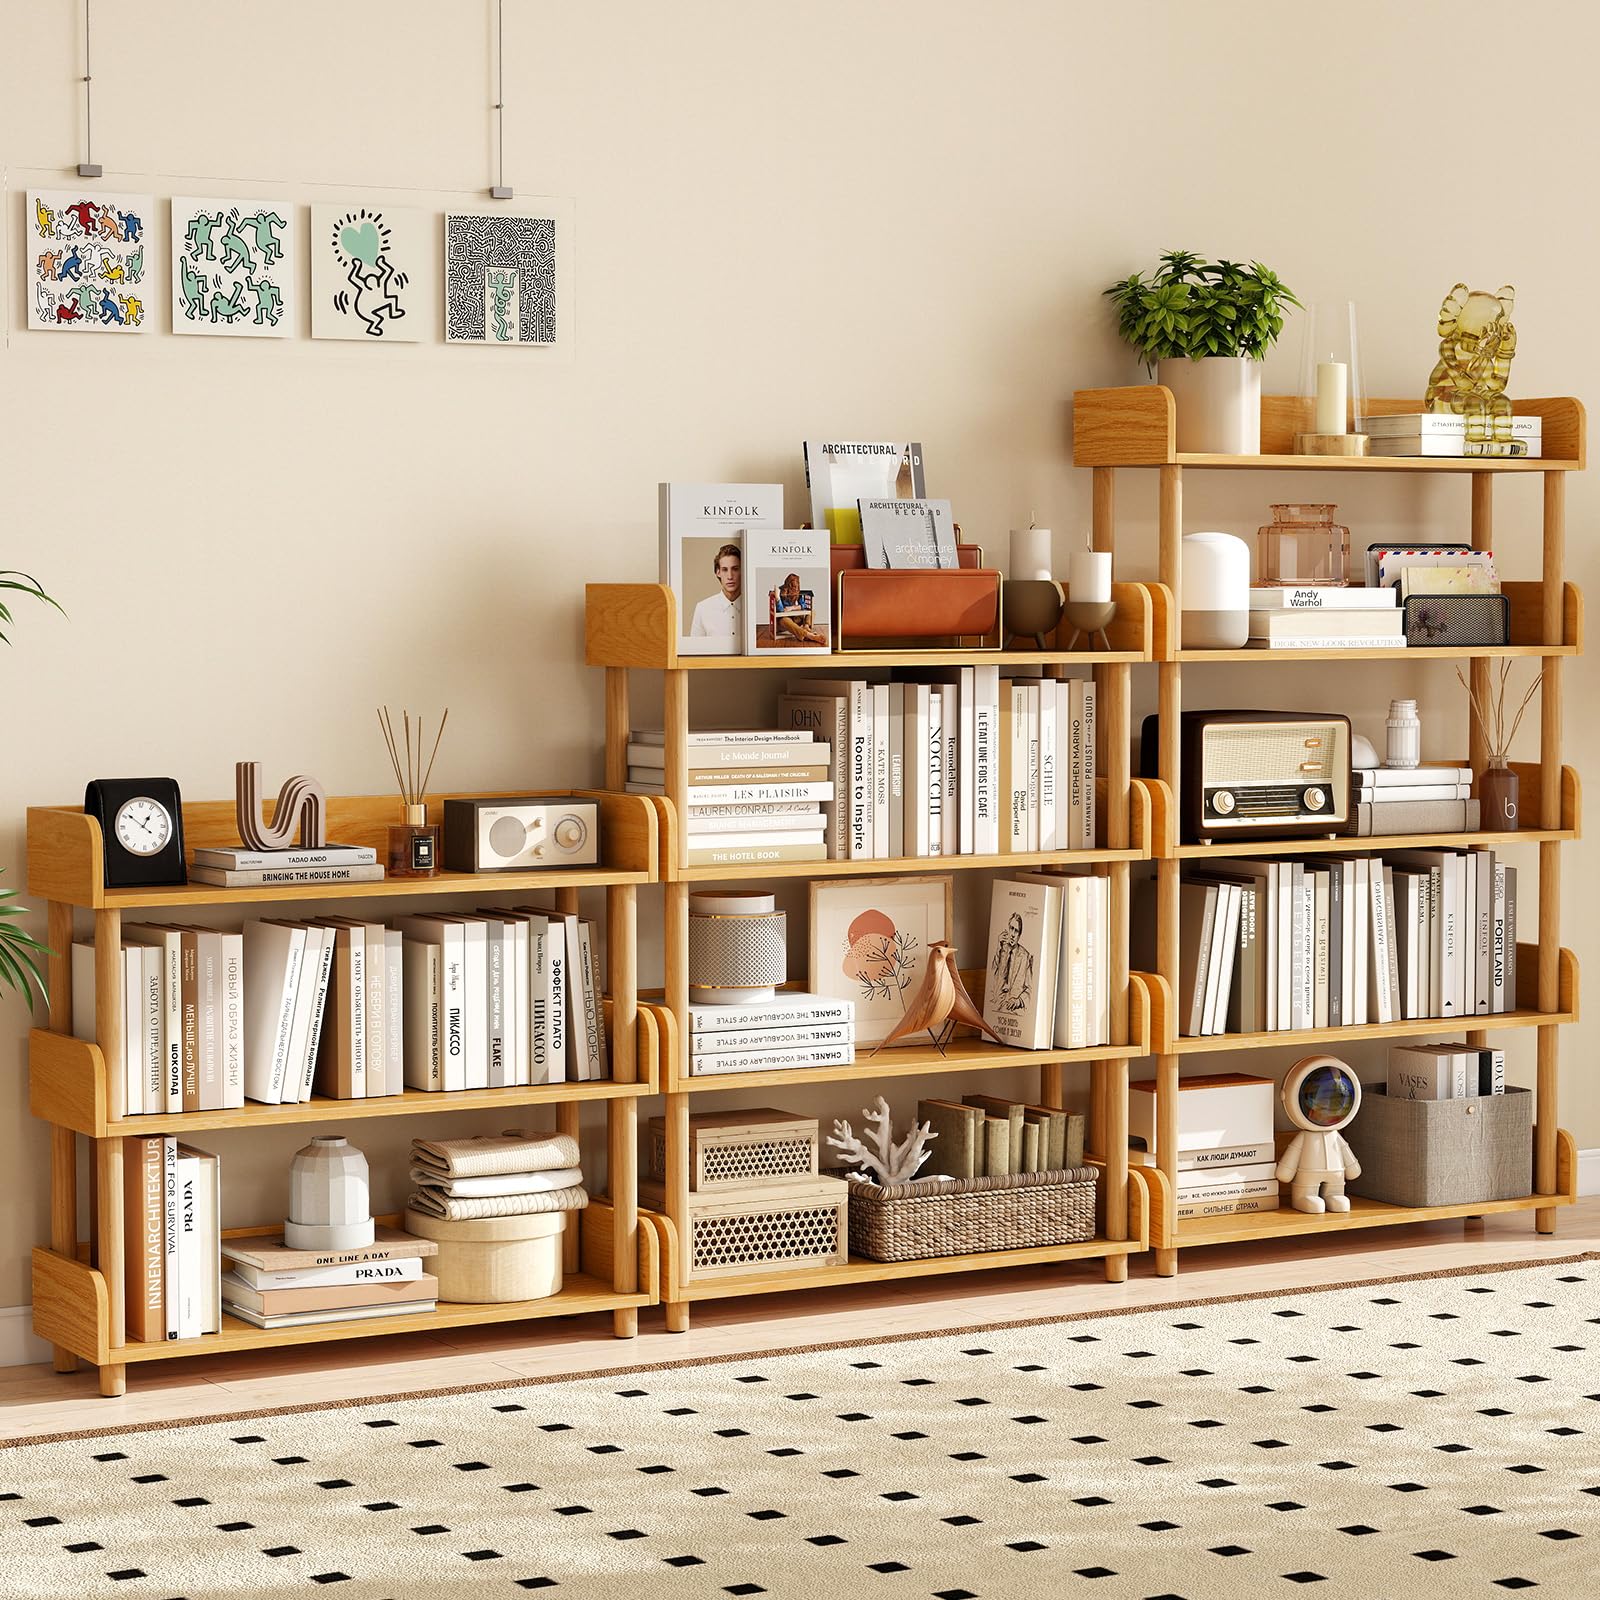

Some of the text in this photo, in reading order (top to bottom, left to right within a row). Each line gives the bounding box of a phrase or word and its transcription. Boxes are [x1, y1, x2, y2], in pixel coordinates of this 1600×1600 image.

[822, 444, 897, 455] ARCHITECTURAL
[704, 505, 760, 516] KINFOLK
[869, 502, 923, 510] ARCHITECTURAL
[771, 545, 813, 554] KINFOLK
[895, 540, 954, 554] architecture
[1294, 590, 1318, 600] Andy
[1290, 598, 1322, 607] Warhol
[1348, 636, 1403, 647] REVOLUTION
[978, 712, 987, 720] IL
[1085, 696, 1093, 724] SQUID
[792, 710, 822, 728] JOHN
[754, 735, 773, 743] Design
[978, 722, 988, 745] ÉTAIT
[721, 750, 789, 761] Le Monde Journal
[978, 747, 987, 763] UNE
[930, 726, 941, 814] NOGUCHI
[948, 737, 956, 797] Remodelista
[978, 766, 987, 784] FOIS
[1029, 740, 1038, 809] Isamu Noguchi
[1044, 755, 1053, 806] SCHIELE
[1072, 761, 1080, 806] STEPHEN
[734, 788, 809, 800] LES PLAISIRS
[839, 787, 846, 799] DE
[853, 737, 865, 850] Rooms to Inspire
[692, 806, 732, 817] LAUREN
[735, 804, 775, 815] CONRAD
[978, 797, 988, 818] CAFÉ
[288, 855, 328, 864] TADAO ANDO
[712, 851, 780, 861] THE HOTEL BOOK
[262, 870, 350, 882] BRINGING THE HOUSE HOME
[1495, 919, 1504, 987] PORTLAND
[371, 976, 381, 989] НЕ
[150, 975, 158, 1014] ЗАБОТА
[316, 988, 325, 1017] Религия
[372, 992, 381, 1019] БЕРИ
[553, 959, 562, 1050] ЭФФЕКТ ПЛАТО
[738, 1015, 748, 1023] OF
[750, 1012, 795, 1022] VOCABULARY
[796, 1011, 809, 1020] THE
[810, 1008, 842, 1019] CHANEL
[229, 958, 238, 1086] НОВЫЙ ОБРАЗ ЖИЗНИ
[586, 989, 599, 1062] НЬЮ-ЙОРК
[716, 1017, 737, 1025] STYLE
[310, 1018, 318, 1048] черной
[450, 1008, 460, 1056] ПИКАССО
[534, 999, 545, 1065] ПИКАССО
[750, 1033, 795, 1043] VOCABULARY
[796, 1032, 809, 1040] THE
[810, 1030, 842, 1039] CHANEL
[716, 1038, 737, 1046] STYLE
[738, 1036, 748, 1044] OF
[372, 1031, 382, 1073] ГОЛОВУ
[492, 1038, 502, 1067] FLAKE
[796, 1053, 809, 1061] THE
[810, 1051, 842, 1060] CHANEL
[150, 1027, 160, 1094] ПРЕДАННЫХ
[716, 1058, 737, 1067] STYLE
[738, 1057, 748, 1065] OF
[750, 1054, 795, 1064] VOCABULARY
[170, 1043, 179, 1096] ШОКОЛАД
[304, 1048, 314, 1087] водолазки
[1495, 1056, 1504, 1082] YOU
[1399, 1073, 1429, 1090] VASES
[1210, 1153, 1229, 1162] ЛЮДИ
[1230, 1150, 1257, 1160] ДУМАЮТ
[167, 1145, 176, 1255] ART FOR SURVIVAL
[184, 1180, 194, 1233] PRADA
[1203, 1205, 1233, 1214] СИЛЬНЕЕ
[1236, 1202, 1259, 1211] СТРАХА
[147, 1138, 161, 1310] INNENARCHITEKTUR
[316, 1252, 390, 1265] ONE LINE A DAY
[355, 1266, 404, 1279] PRADA
